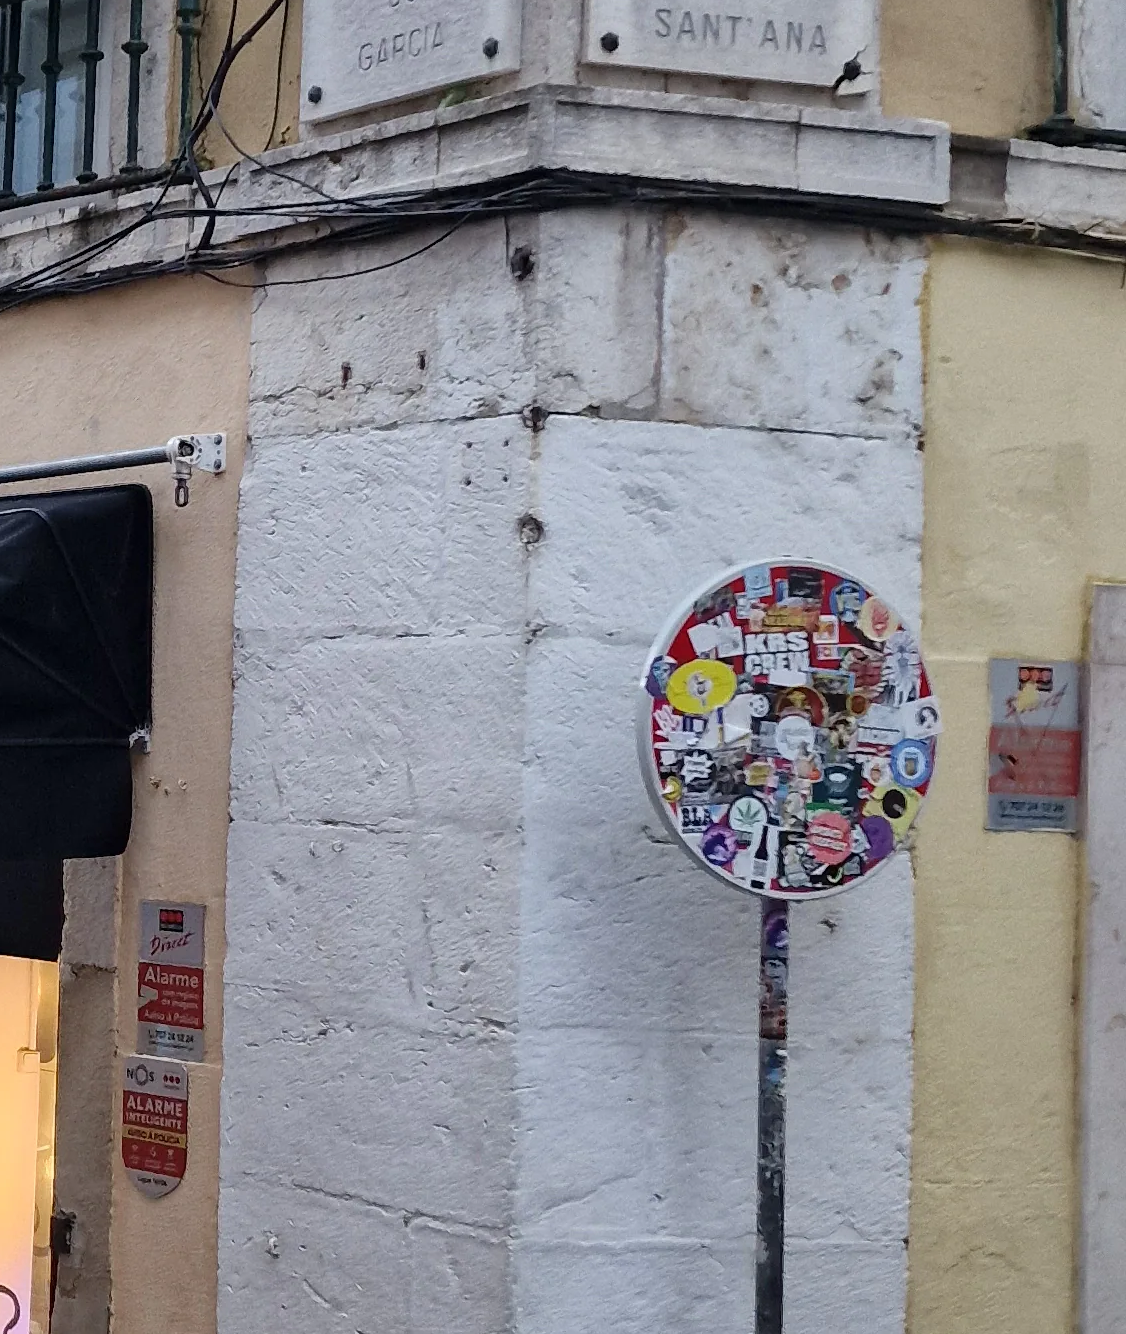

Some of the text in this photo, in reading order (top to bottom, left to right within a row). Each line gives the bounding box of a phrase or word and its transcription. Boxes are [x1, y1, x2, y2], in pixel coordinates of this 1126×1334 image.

[358, 21, 443, 71] GARCIA
[144, 966, 199, 988] Alarme
[126, 1064, 155, 1086] NOS
[127, 1094, 183, 1117] ALARME
